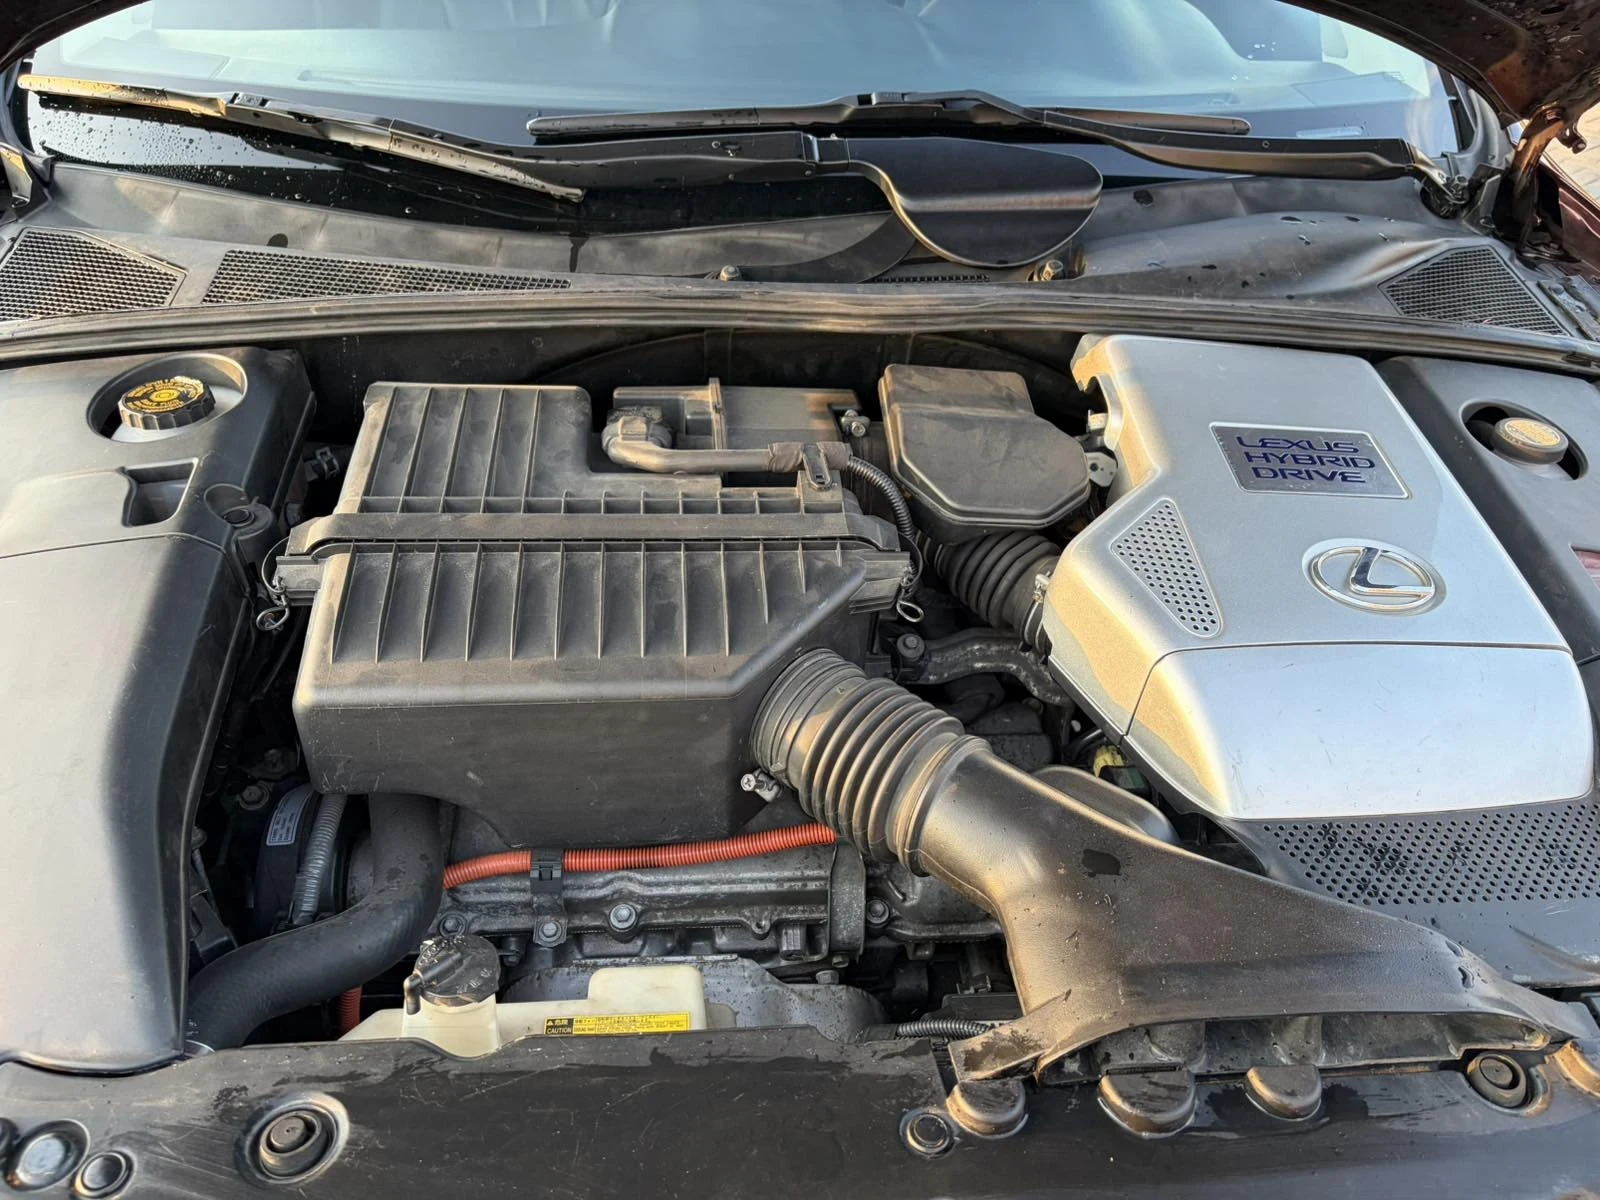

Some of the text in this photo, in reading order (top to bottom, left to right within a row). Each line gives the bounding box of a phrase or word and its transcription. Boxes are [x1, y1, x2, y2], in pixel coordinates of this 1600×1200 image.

[1236, 436, 1359, 453] LEXUS
[1244, 451, 1376, 469] HYBRID
[1252, 467, 1366, 483] DRIVE
